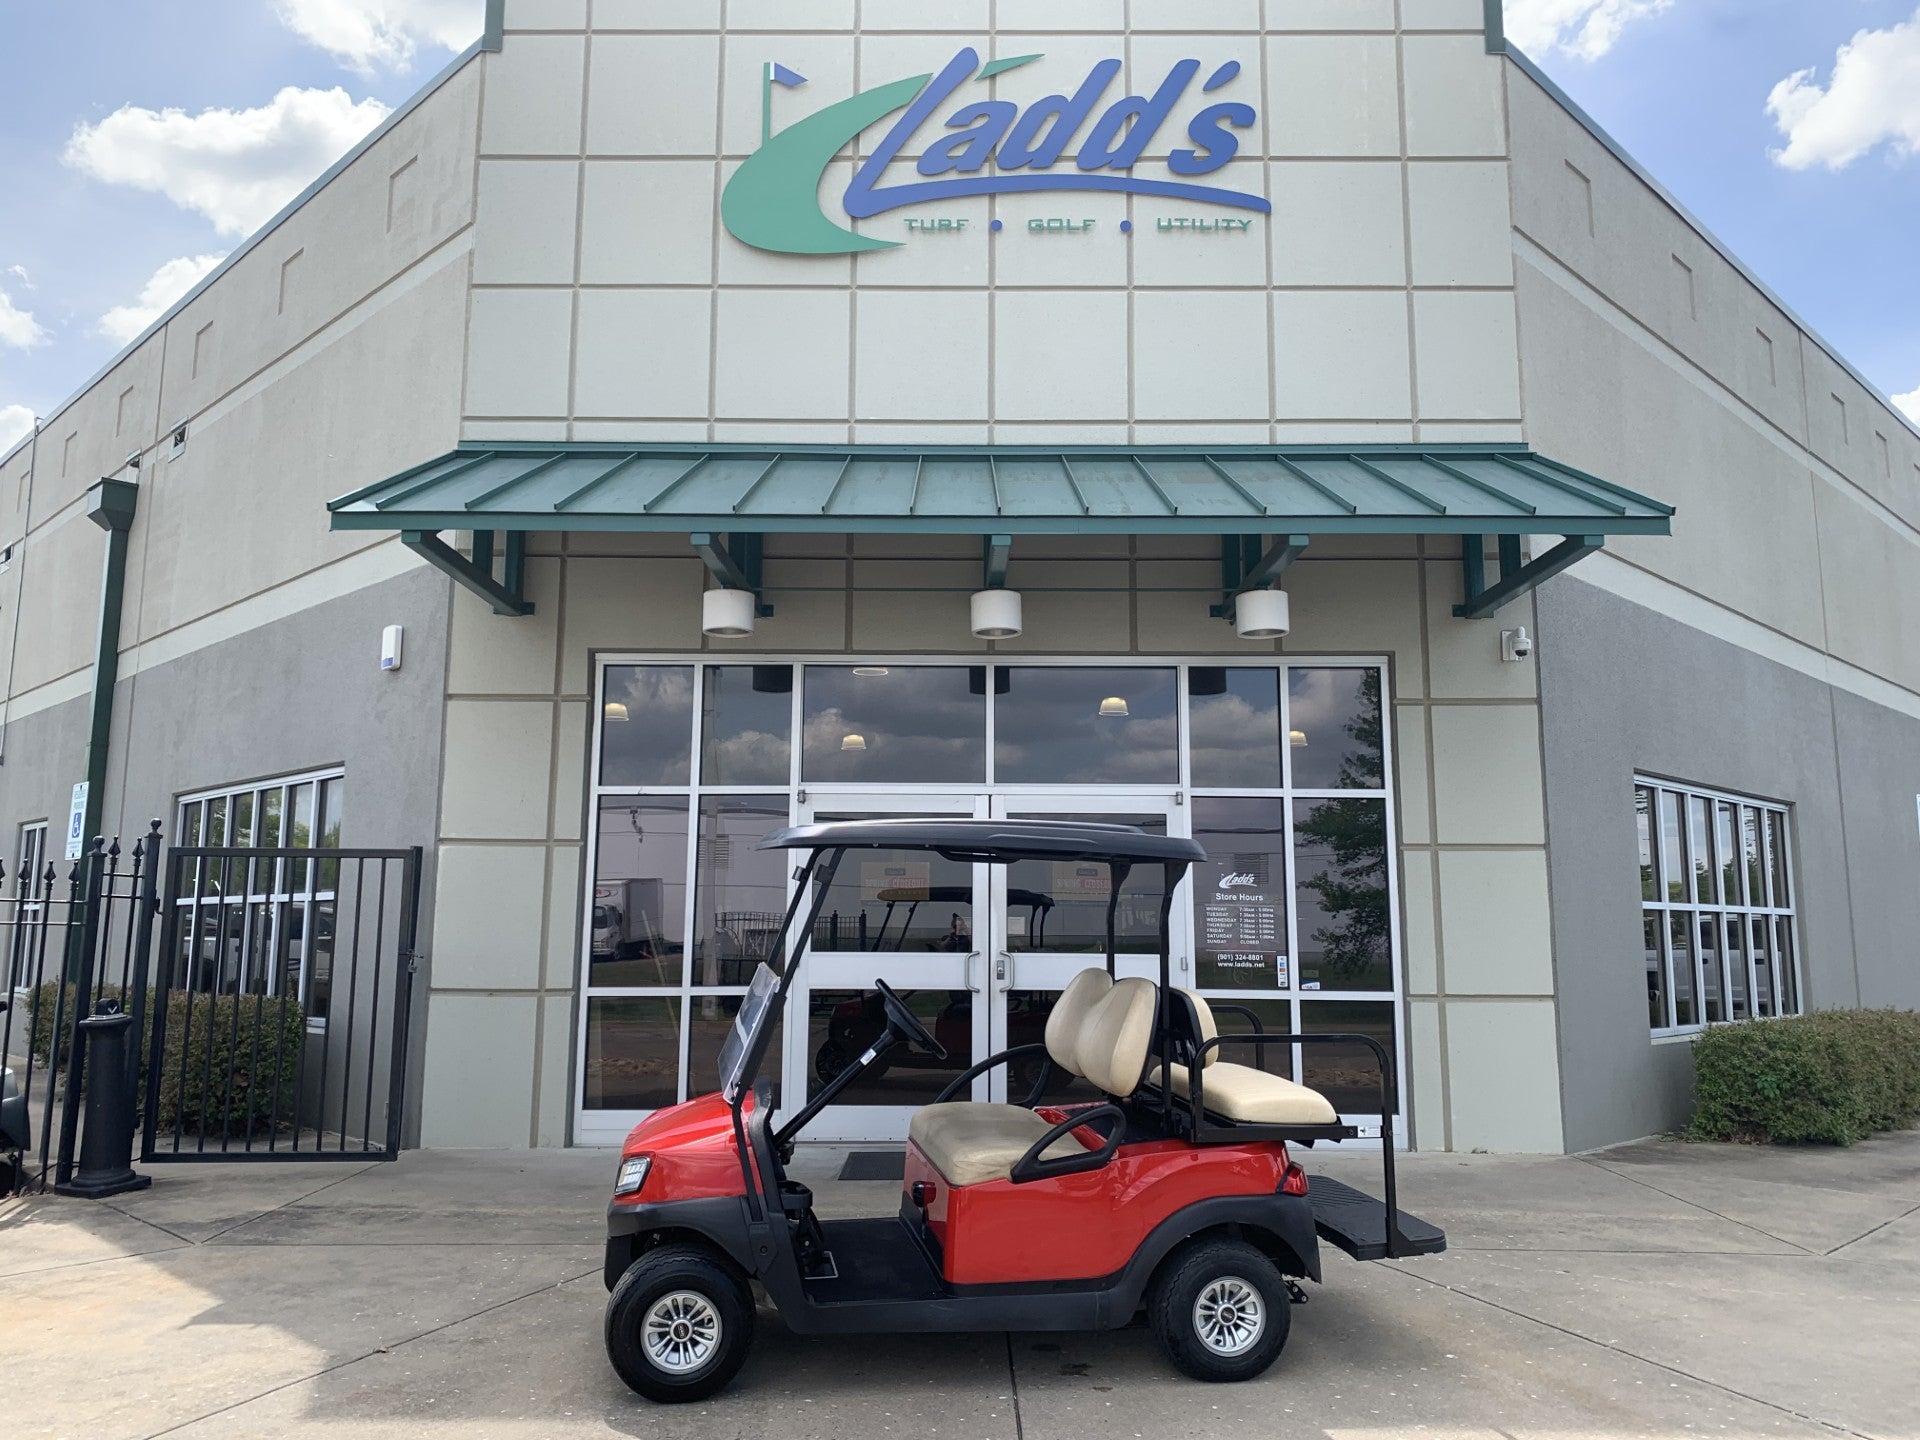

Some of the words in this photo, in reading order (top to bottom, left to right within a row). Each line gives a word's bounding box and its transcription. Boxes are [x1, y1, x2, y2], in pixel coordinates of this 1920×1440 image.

[843, 47, 1271, 218] Ladd's
[904, 218, 969, 232] TURF
[1027, 218, 1096, 232] GOLF
[1156, 217, 1253, 233] UTILITY
[1226, 872, 1257, 887] Ladd's
[1215, 892, 1237, 901] Store
[1239, 893, 1264, 902] Hours
